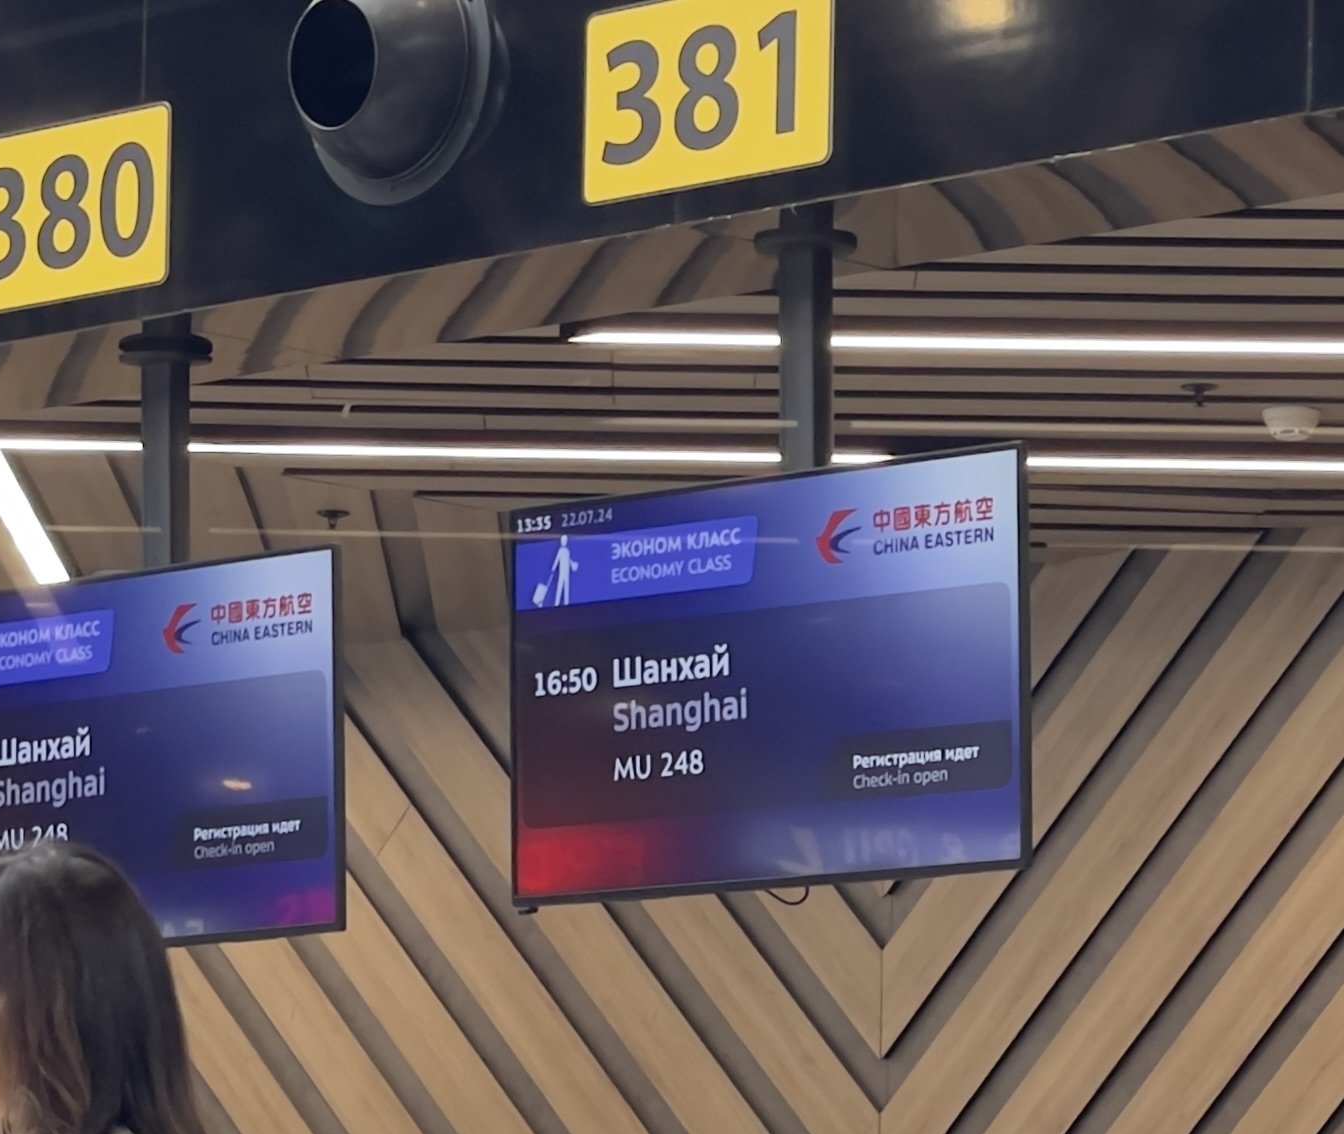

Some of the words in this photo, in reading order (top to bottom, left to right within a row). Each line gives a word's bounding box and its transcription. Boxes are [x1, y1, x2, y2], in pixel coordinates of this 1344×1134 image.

[601, 9, 797, 166] 381
[516, 514, 552, 533] 13:35
[561, 507, 613, 527] 22.07.24
[873, 496, 994, 533] 中國東方航空
[611, 535, 682, 560] ЭКОНОМ
[687, 528, 741, 551] КЛАСС
[873, 536, 920, 556] CHINA
[925, 526, 994, 551] EASTERN
[611, 559, 683, 584] ECONOMY
[688, 554, 732, 574] CLASS
[210, 592, 313, 624] 中國東方航空
[55, 620, 101, 642] КЛАСС
[211, 629, 250, 647] CHINA
[254, 620, 313, 641] EASTERN
[57, 645, 93, 663] CLASS
[612, 643, 730, 689] Шанхай
[534, 666, 598, 698] 16:50
[612, 688, 748, 735] Shanghai
[613, 755, 651, 782] MU
[661, 749, 704, 778] 248
[853, 747, 942, 770] Регистрация
[945, 744, 980, 764] идет
[853, 769, 911, 790] Check-in
[914, 768, 948, 788] open
[193, 822, 269, 843] Регистрация
[272, 818, 301, 835] идет
[193, 841, 242, 860] Check-in
[245, 840, 275, 857] open
